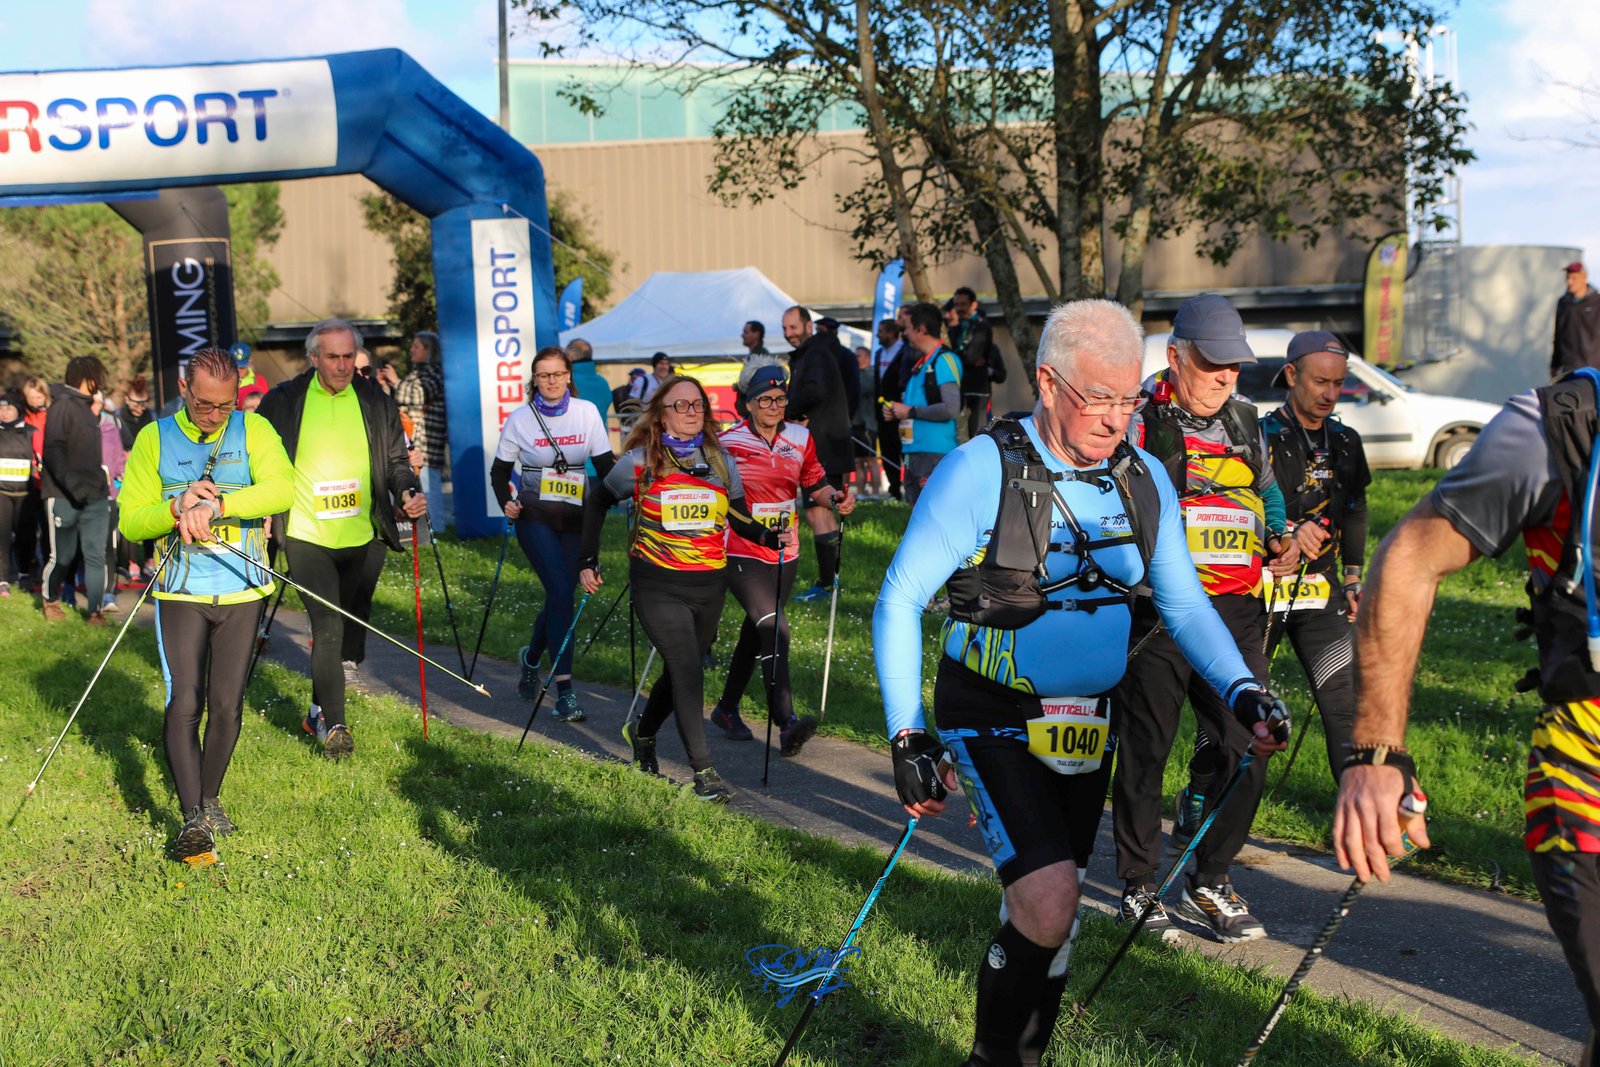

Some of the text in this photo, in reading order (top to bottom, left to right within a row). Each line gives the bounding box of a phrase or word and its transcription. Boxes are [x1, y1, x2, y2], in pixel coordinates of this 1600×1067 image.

[490, 247, 525, 432] TERSPORT
[532, 433, 587, 448] POTICELLI
[548, 480, 577, 495] 1018
[322, 493, 356, 509] 1038
[670, 504, 709, 519] 1029
[1199, 528, 1249, 550] 1027
[1045, 726, 1100, 755] 1040
